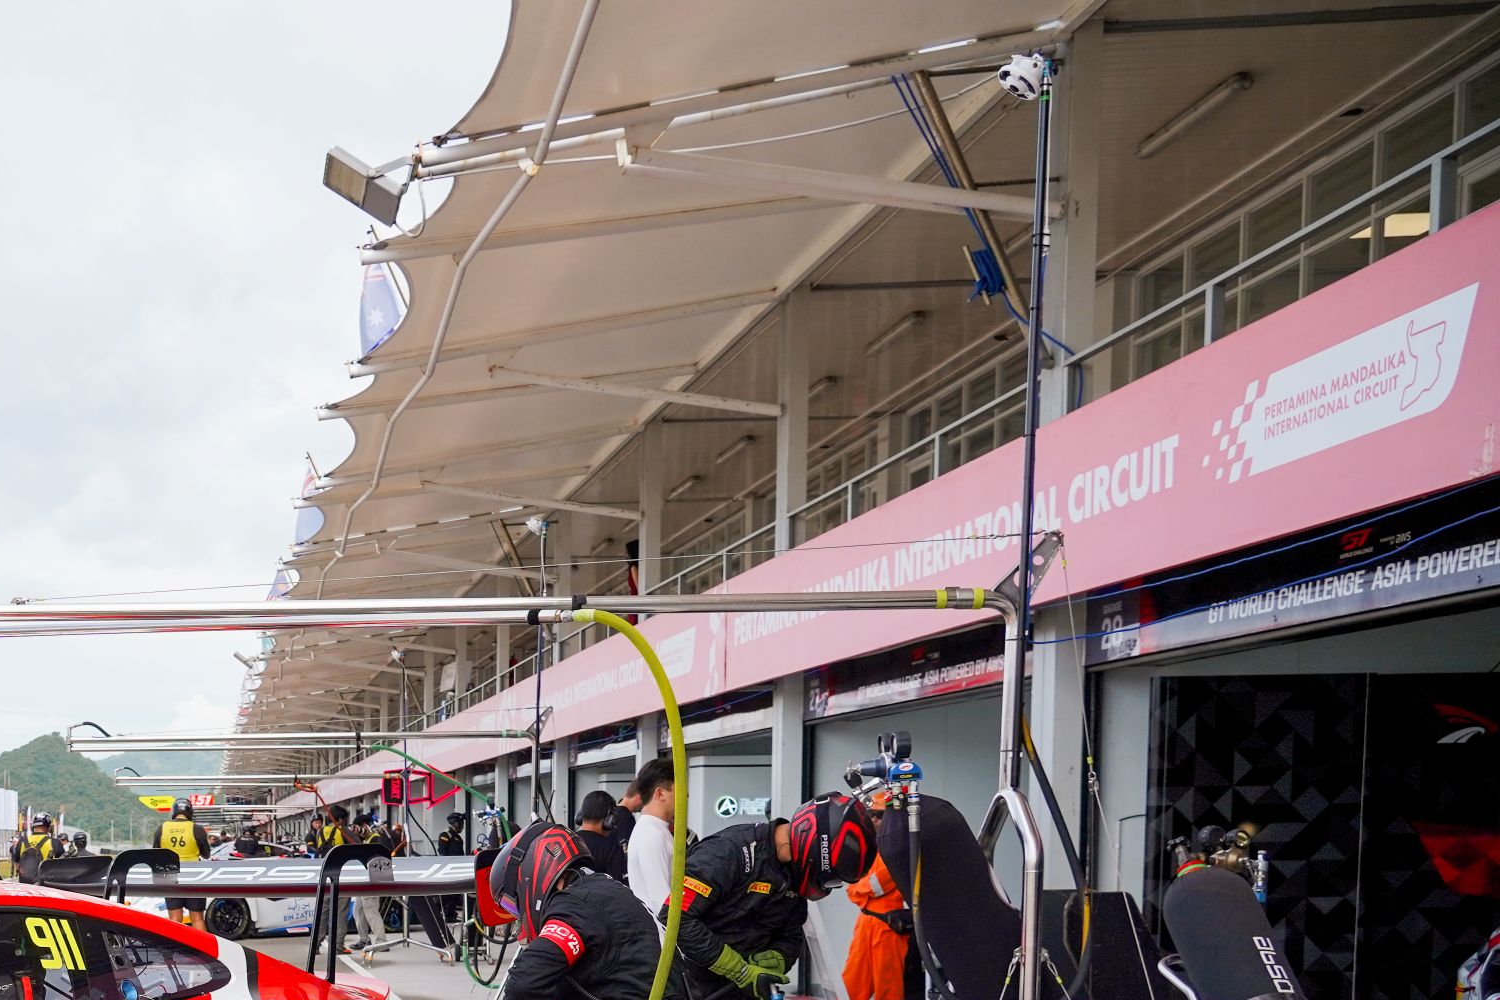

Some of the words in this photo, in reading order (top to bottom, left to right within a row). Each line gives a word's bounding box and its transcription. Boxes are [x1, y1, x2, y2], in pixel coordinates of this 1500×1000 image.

[1264, 384, 1327, 421] PERTAMINA
[1330, 351, 1406, 393] MANDALIKA
[1264, 400, 1349, 441] INTERNATIONAL
[1353, 375, 1399, 405] CIRCUIT
[894, 486, 1062, 588] INTERNATIONAL
[1067, 435, 1179, 524] CIRCUIT
[1208, 602, 1227, 624] GT
[1228, 589, 1275, 622] WORLD
[1277, 569, 1363, 610] CHALLENGE
[1371, 560, 1412, 591] ASIA
[923, 671, 939, 687] ASIA
[940, 661, 974, 684] POWERED
[975, 658, 986, 675] BY
[986, 654, 1004, 672] AWS
[170, 836, 186, 847] 96
[822, 834, 830, 870] PROPRO
[24, 917, 87, 971] 911
